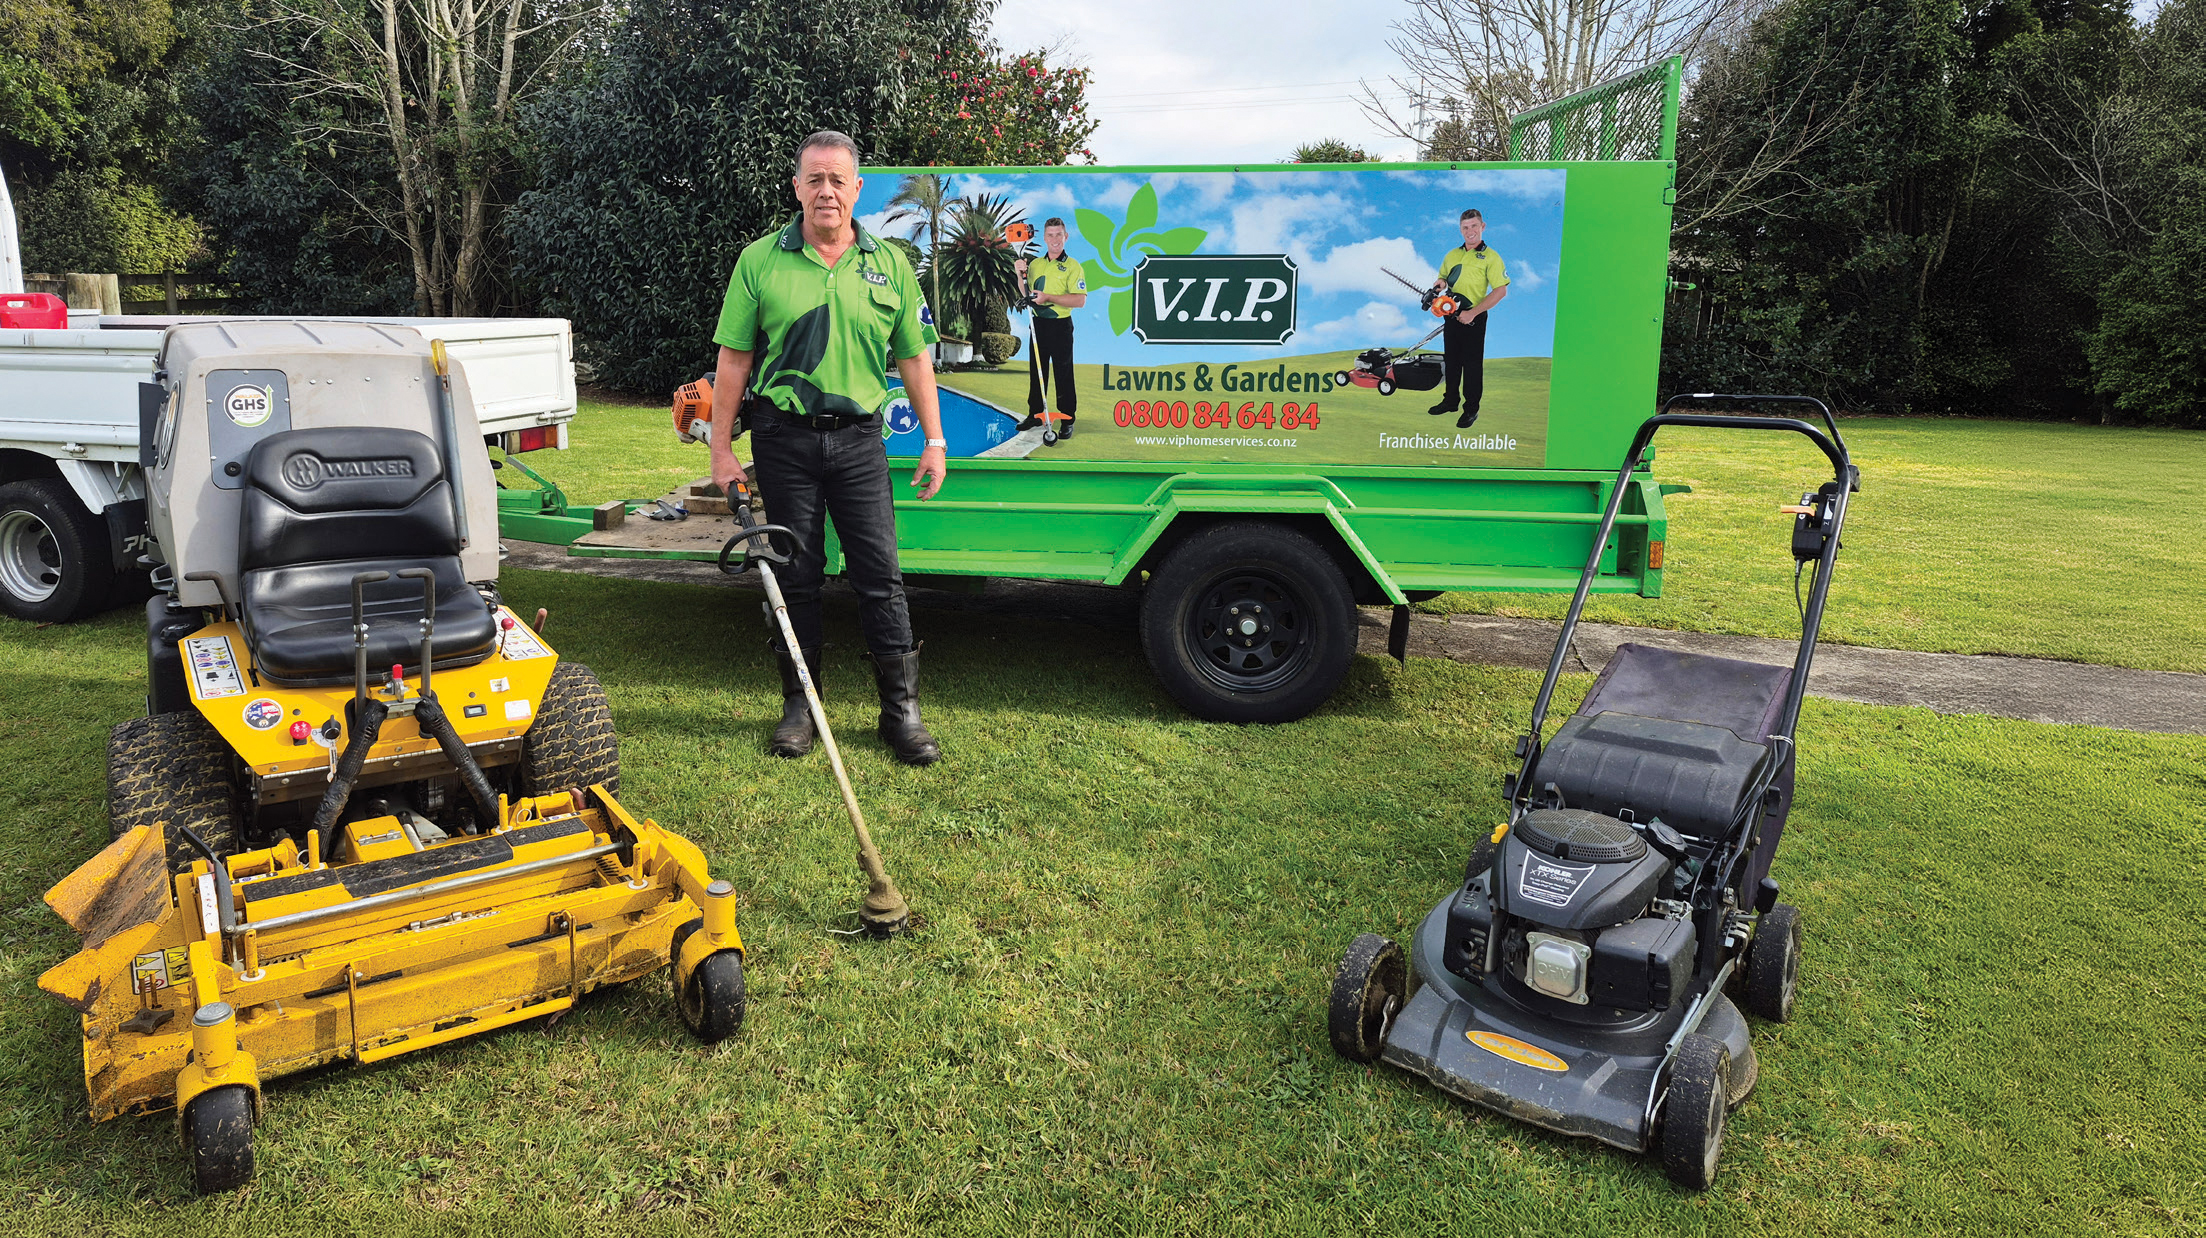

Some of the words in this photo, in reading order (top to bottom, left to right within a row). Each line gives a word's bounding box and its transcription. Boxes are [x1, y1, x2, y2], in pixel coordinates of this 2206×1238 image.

[1147, 278, 1288, 323] V.I.P.
[1103, 363, 1187, 392] Lawns
[1193, 364, 1214, 392] &
[1220, 364, 1334, 393] Gardens
[231, 399, 266, 411] GHS
[1113, 399, 1190, 428] 0800
[1192, 401, 1232, 429] 84
[1236, 401, 1276, 430] 64
[1280, 402, 1321, 430] 84
[1135, 434, 1297, 448] www.viphomeservices.co.nz
[1379, 432, 1450, 449] Franchises
[1453, 434, 1517, 451] Available
[324, 460, 412, 478] WALKER
[1529, 868, 1549, 878] XTX
[1549, 874, 1577, 885] Series
[1537, 864, 1573, 878] KOHLER
[1474, 1033, 1561, 1067] tandem
